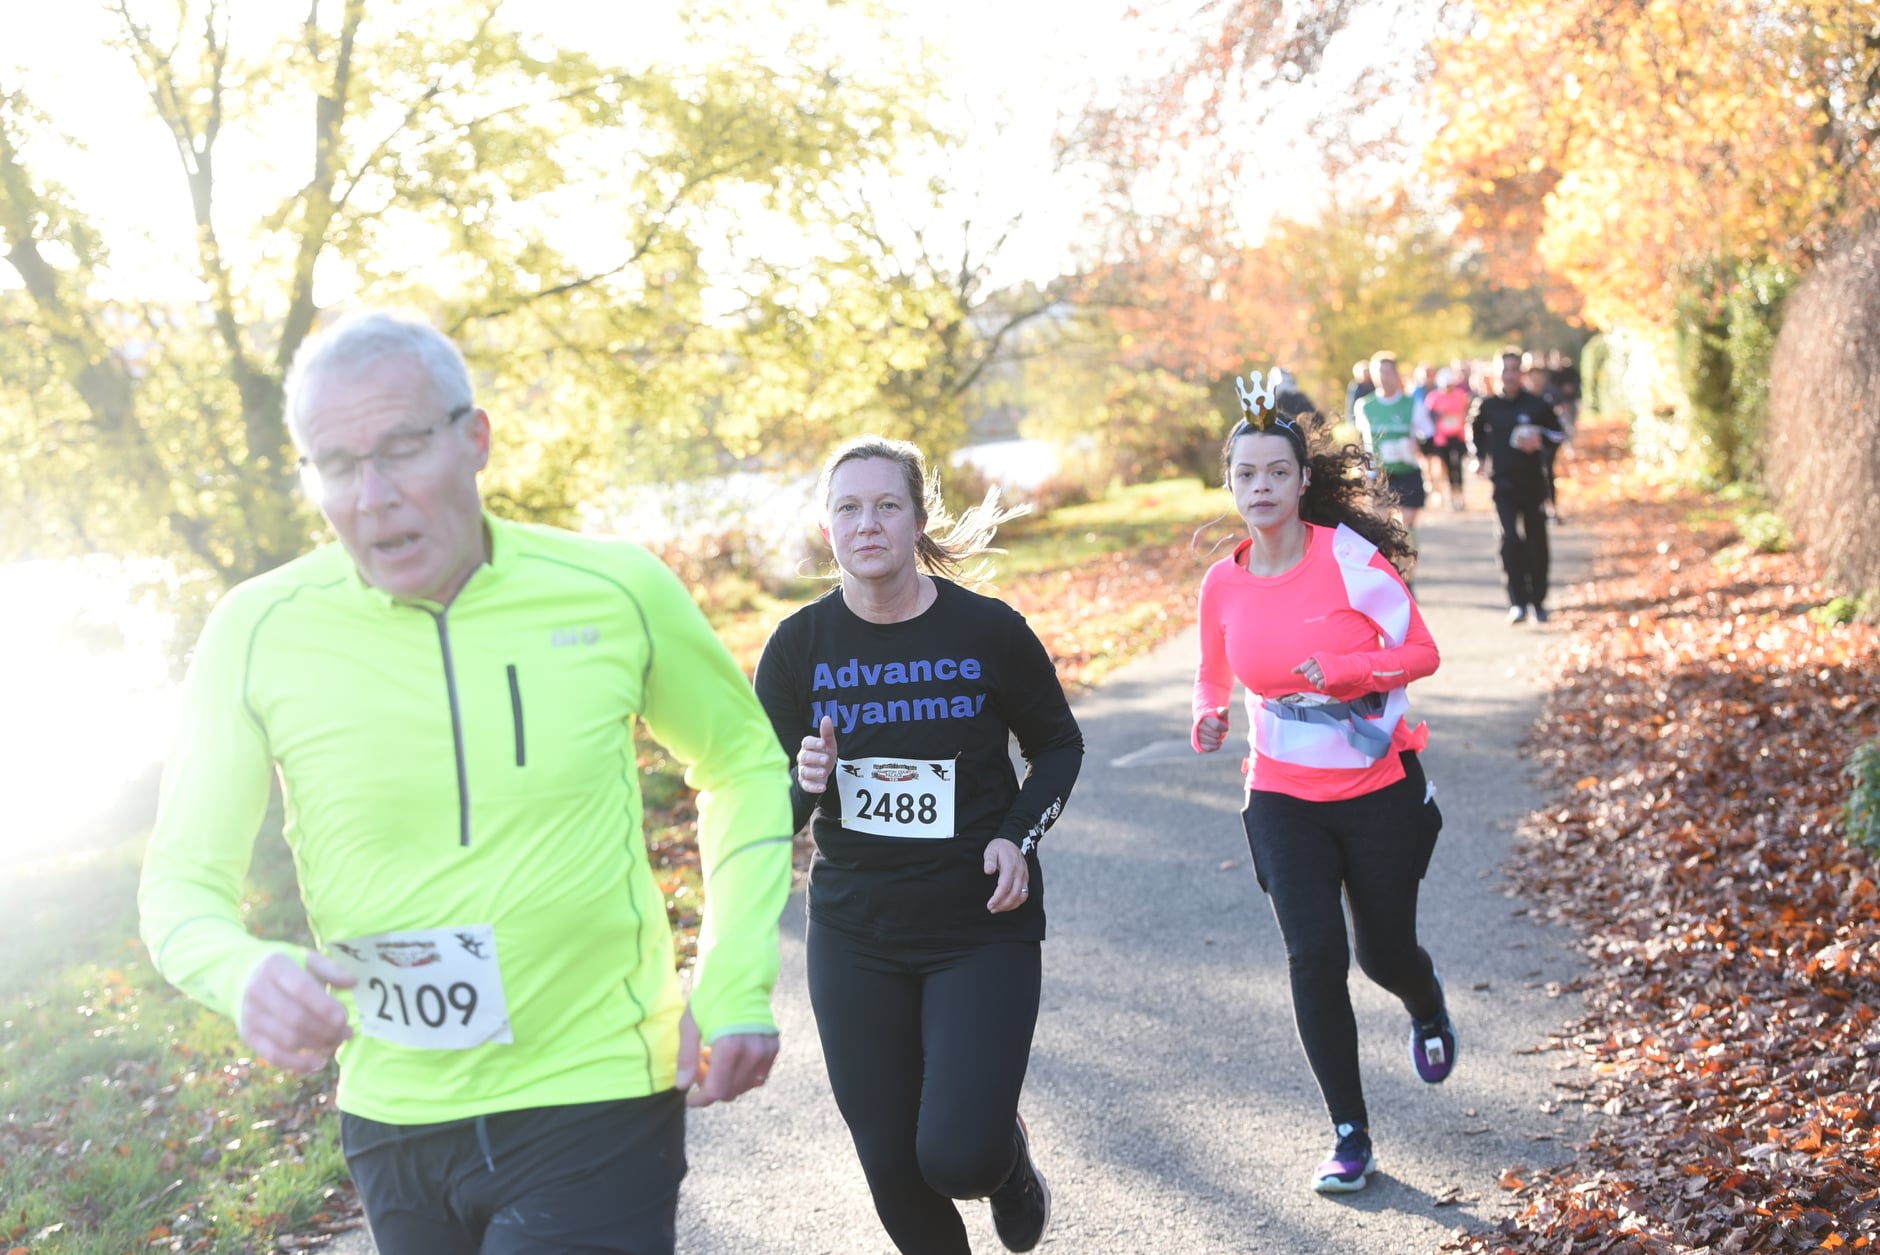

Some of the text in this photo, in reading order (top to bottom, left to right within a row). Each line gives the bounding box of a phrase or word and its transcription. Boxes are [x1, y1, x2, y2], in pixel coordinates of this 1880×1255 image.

[812, 658, 982, 692] Advance
[811, 694, 986, 734] Myanmar
[856, 790, 937, 824] 2488
[368, 977, 479, 1028] 2109
